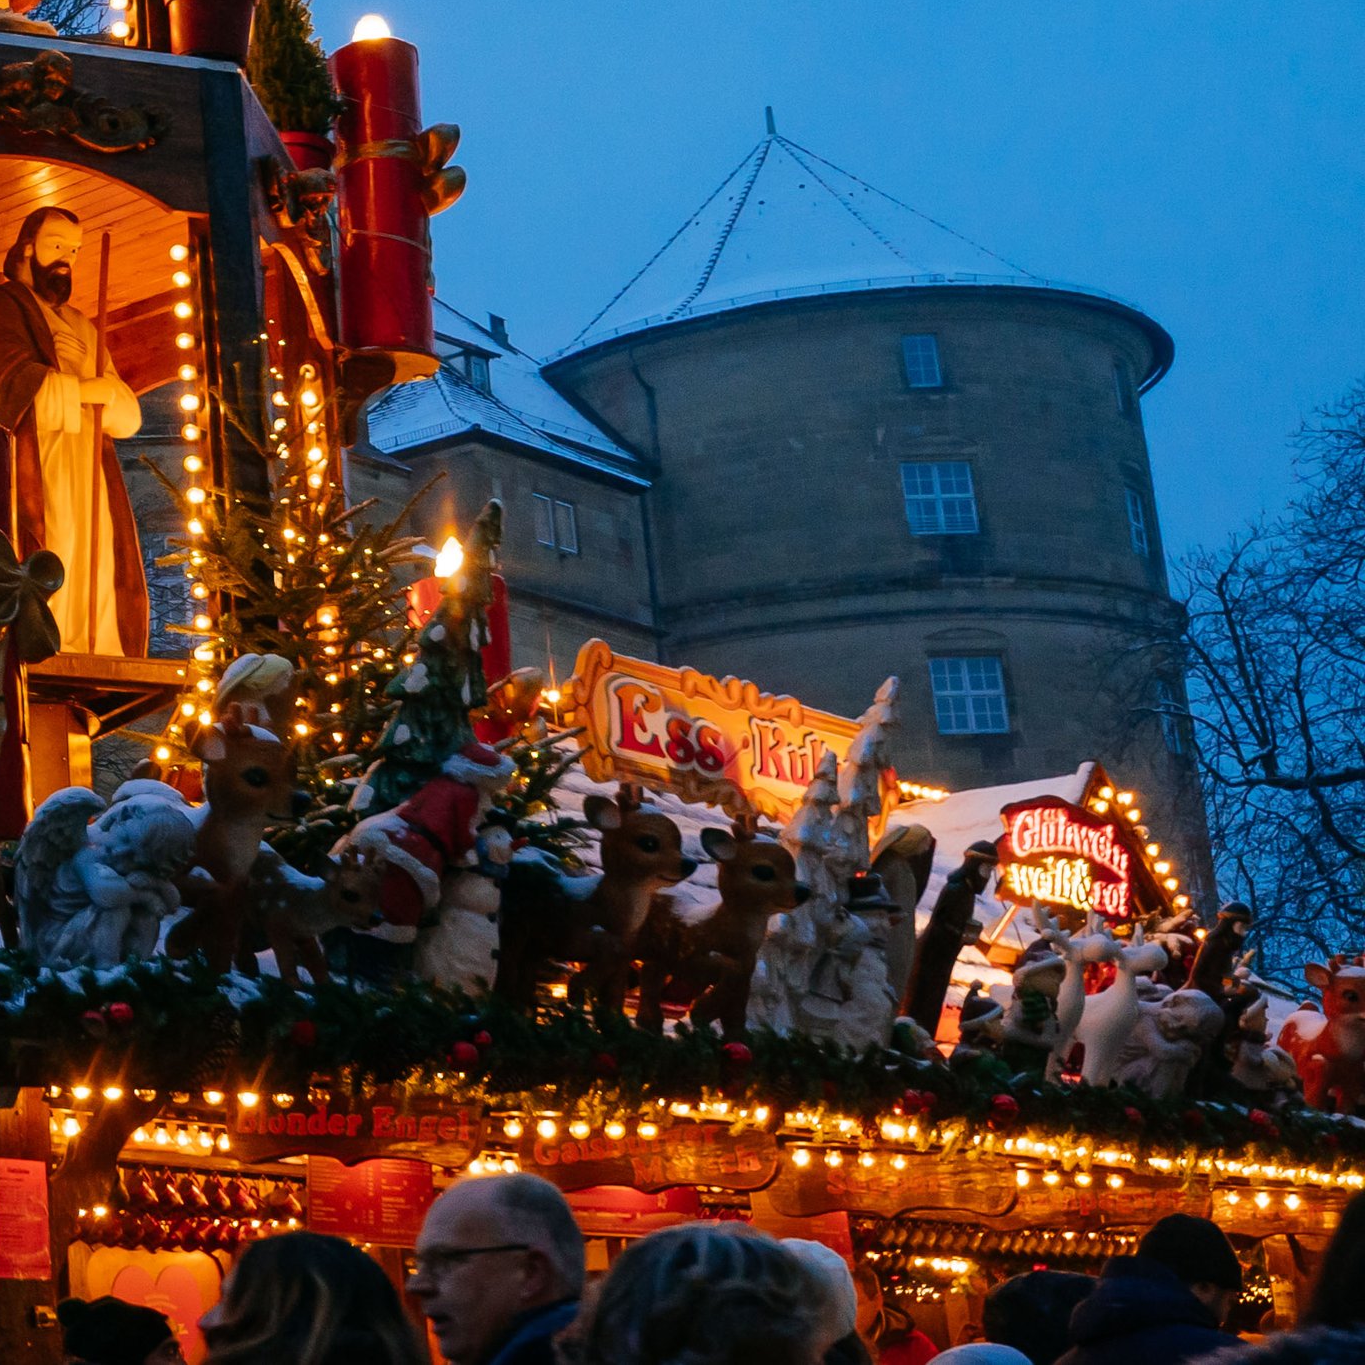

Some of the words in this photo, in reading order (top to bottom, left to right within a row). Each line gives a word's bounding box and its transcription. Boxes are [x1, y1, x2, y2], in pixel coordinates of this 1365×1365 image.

[615, 684, 725, 772] Ess
[757, 723, 846, 787] Kul
[1011, 807, 1129, 882] Glühwein
[1007, 856, 1072, 905] weiß
[372, 1106, 470, 1143] Engel
